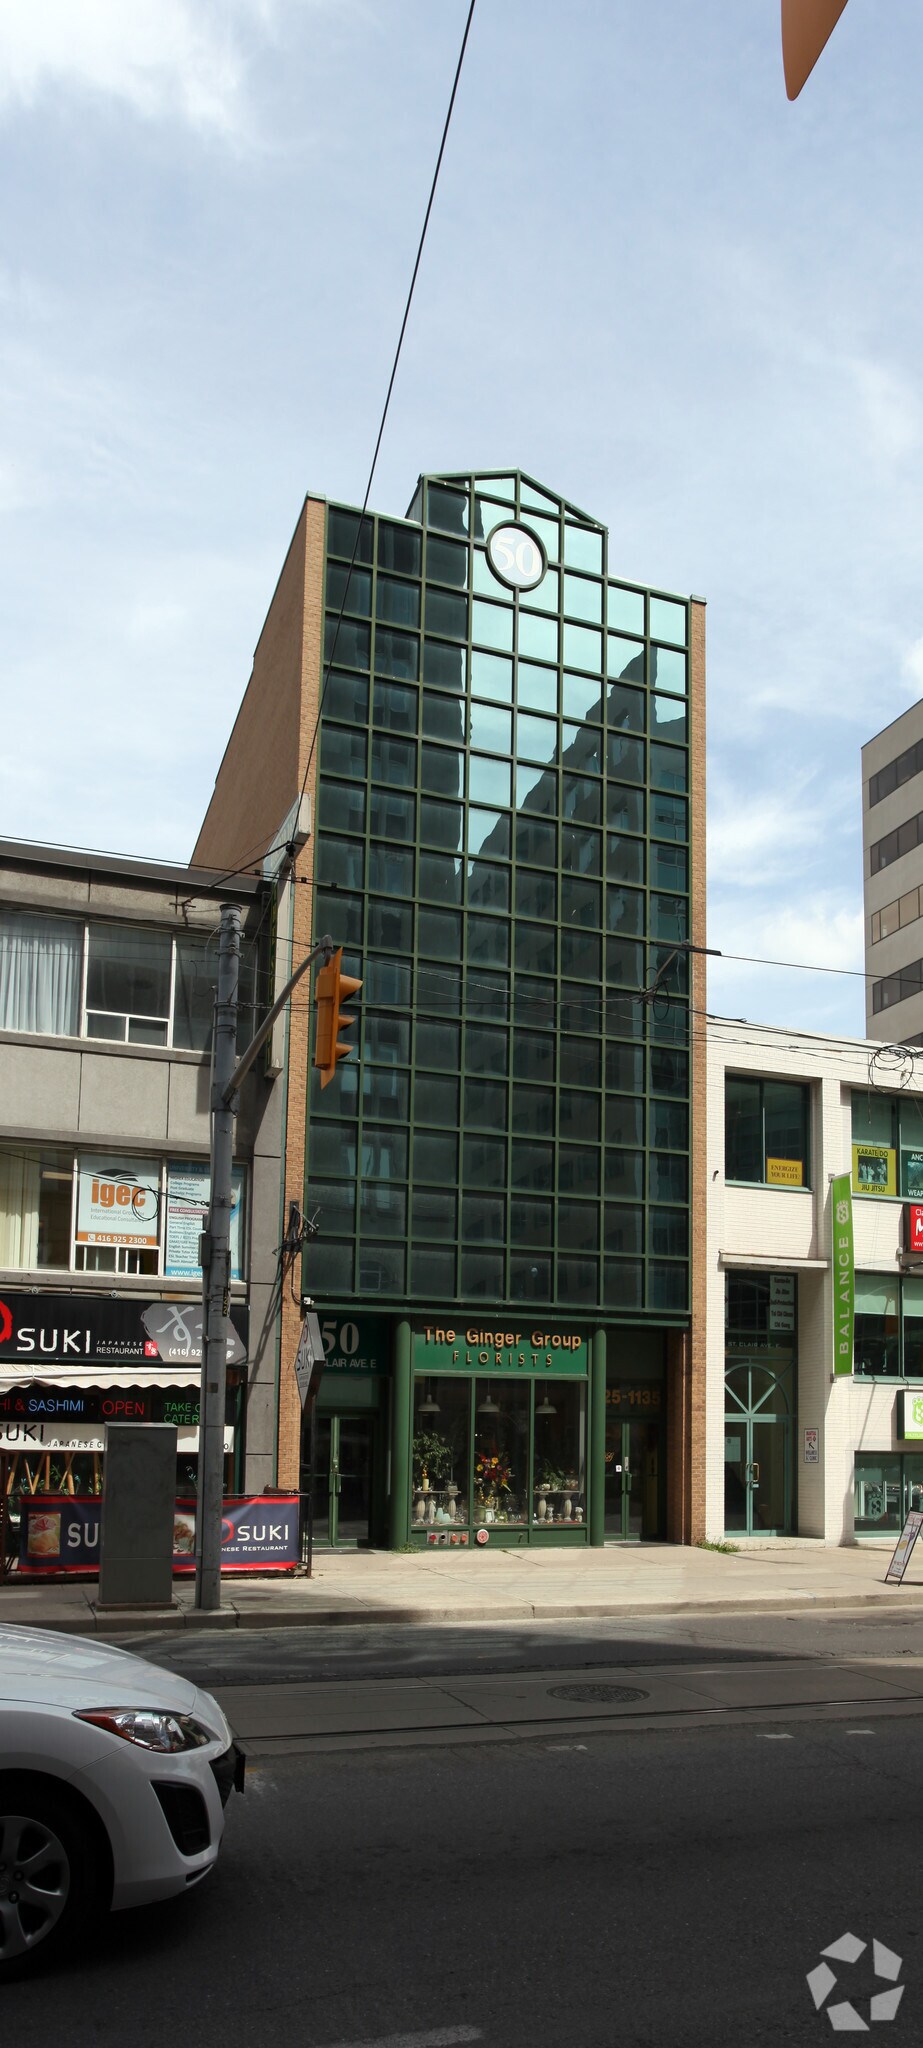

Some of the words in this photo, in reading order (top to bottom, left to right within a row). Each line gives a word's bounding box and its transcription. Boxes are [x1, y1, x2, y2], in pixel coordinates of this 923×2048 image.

[495, 537, 541, 577] 50
[91, 1178, 146, 1209] igec
[90, 1207, 122, 1216] International
[90, 1214, 117, 1222] Educational
[838, 1236, 850, 1355] BALANCE
[16, 1327, 91, 1354] SUKI
[321, 1320, 360, 1355] 50
[424, 1326, 456, 1342] The
[466, 1328, 522, 1348] Ginger
[531, 1331, 582, 1350] Group
[95, 1346, 144, 1356] RESTAURANT
[168, 1347, 190, 1358] (416)
[453, 1351, 553, 1366] FLORISTS
[324, 1358, 347, 1368] LAIR
[15, 1398, 26, 1411] &
[28, 1399, 84, 1412] SASHIMI
[102, 1399, 146, 1416] OPEN
[164, 1402, 192, 1413] TAKE
[47, 1440, 94, 1449] JAPANESE
[237, 1524, 290, 1542] SUKI
